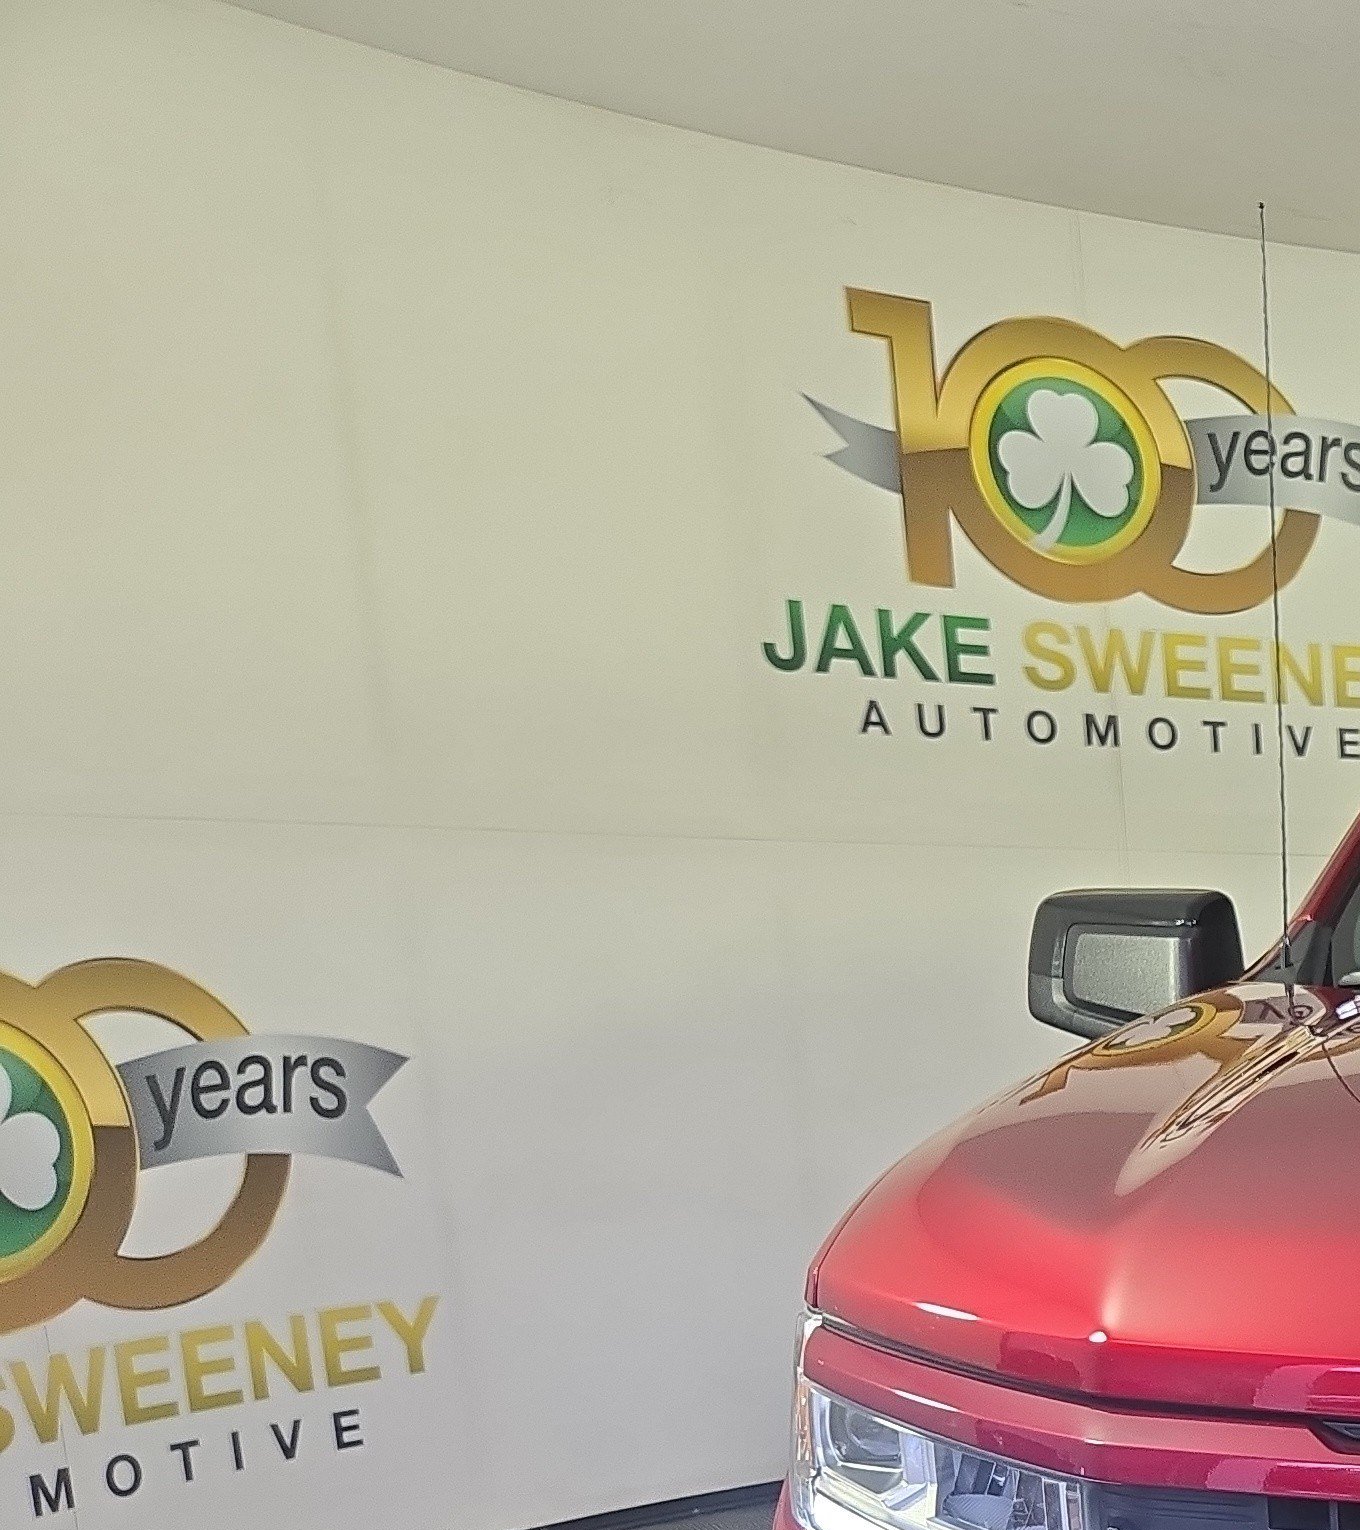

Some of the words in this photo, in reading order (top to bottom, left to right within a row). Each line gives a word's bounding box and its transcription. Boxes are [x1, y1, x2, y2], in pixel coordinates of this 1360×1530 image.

[845, 286, 1322, 633] 100
[762, 600, 997, 687] JAKE
[145, 1051, 348, 1151] years
[0, 1295, 440, 1453] WEENEY
